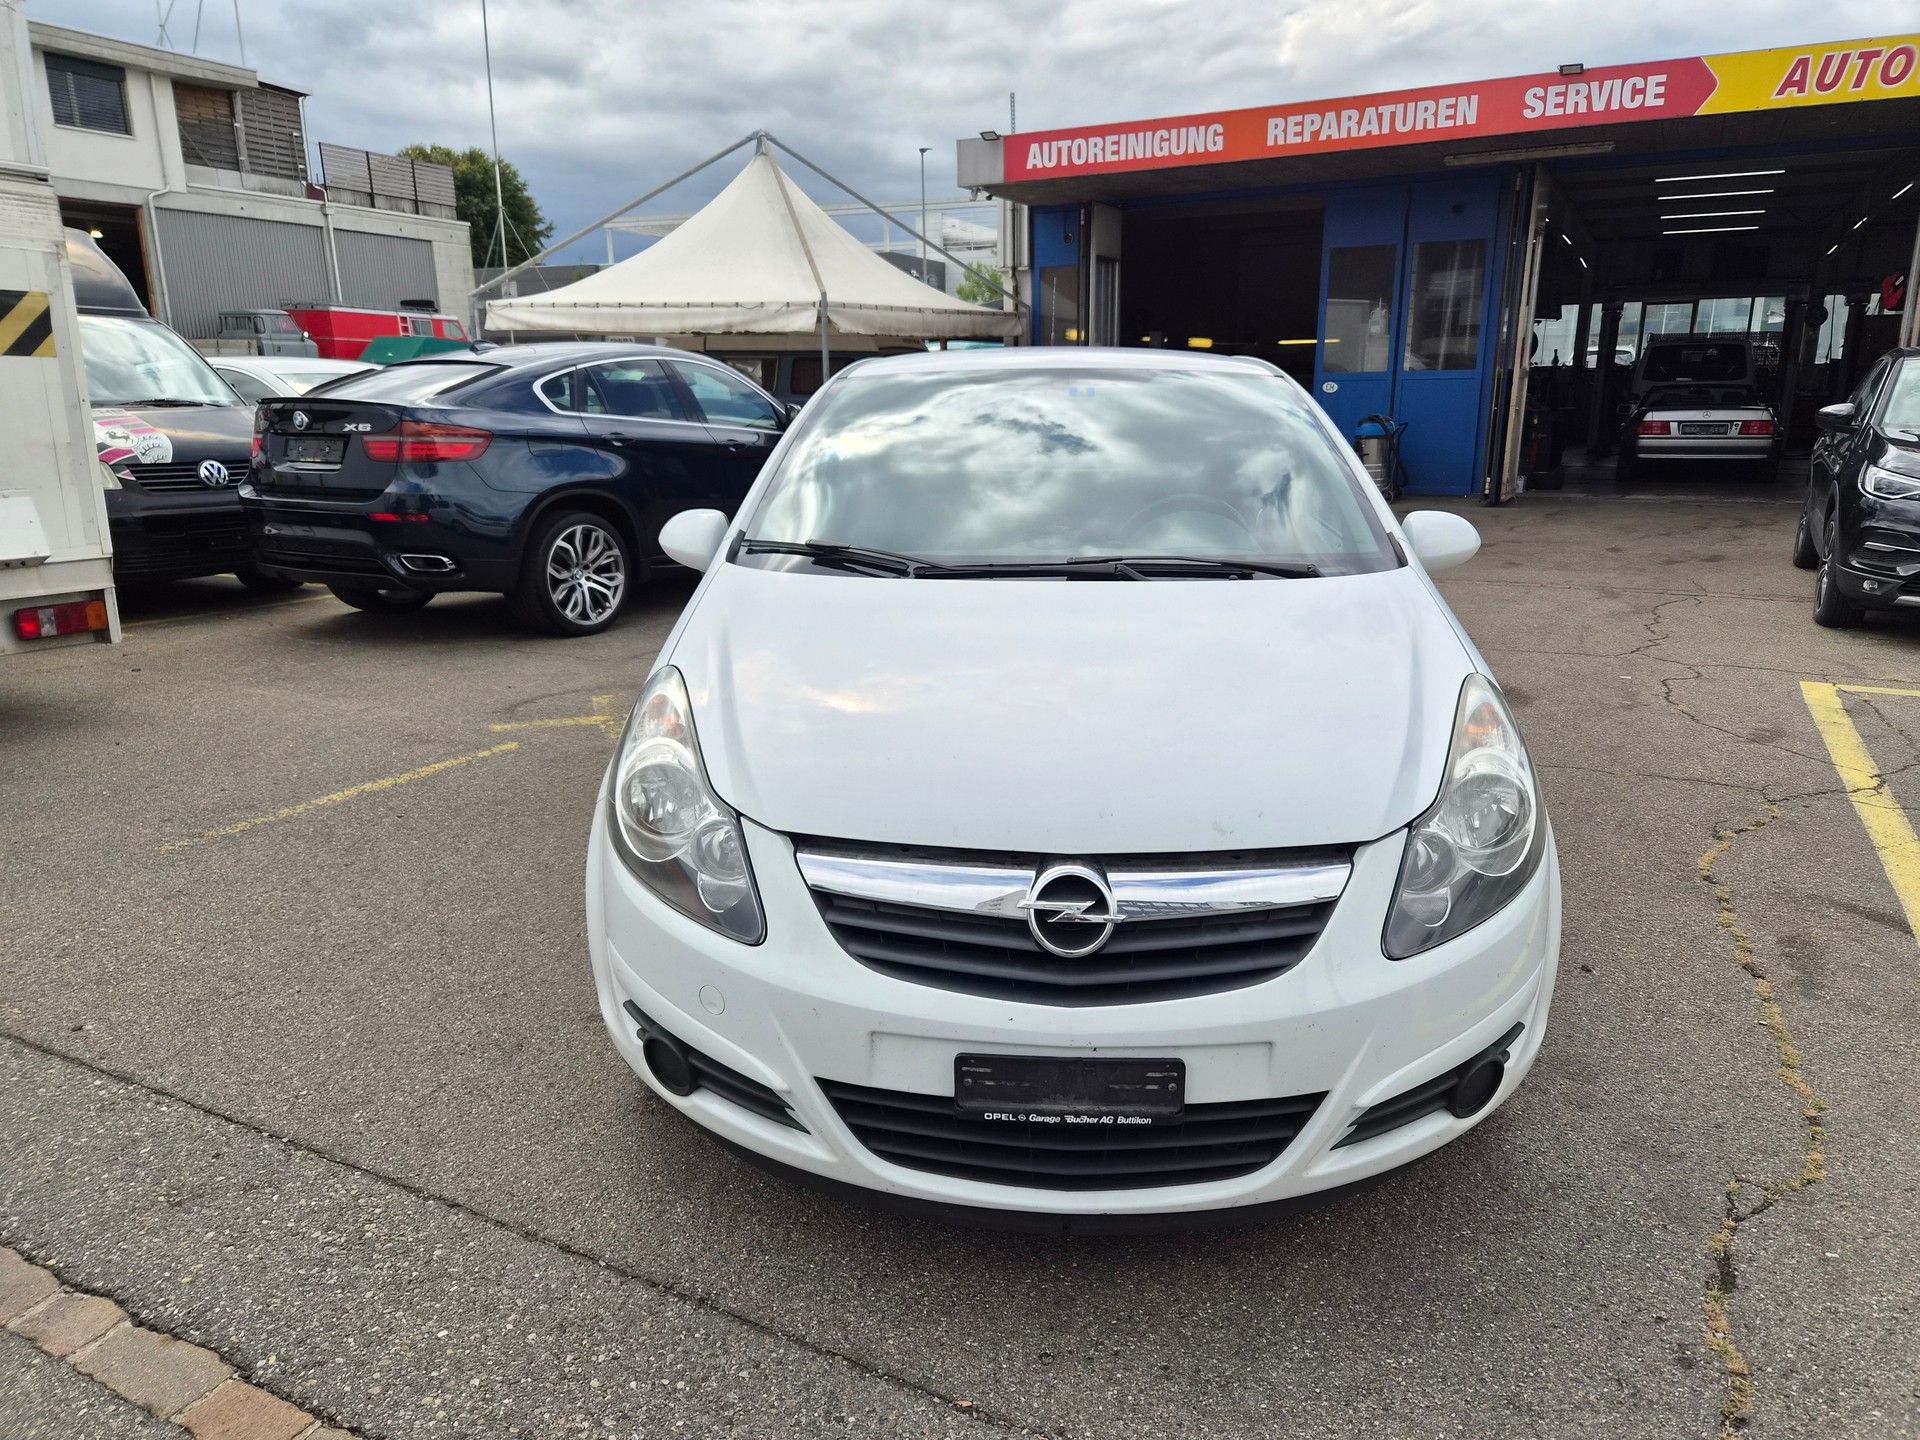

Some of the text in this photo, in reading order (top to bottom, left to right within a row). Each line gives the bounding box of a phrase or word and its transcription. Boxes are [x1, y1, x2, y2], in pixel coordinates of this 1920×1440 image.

[1771, 44, 1920, 98] AUTO
[1026, 74, 1667, 169] AUTOREINIGUNG REPARATUREN SERVICE
[342, 423, 372, 432] X6
[984, 1112, 1016, 1121] OPEL
[1029, 1113, 1061, 1123] Garage
[1099, 1115, 1114, 1124] AG
[1117, 1116, 1152, 1125] Buttikon
